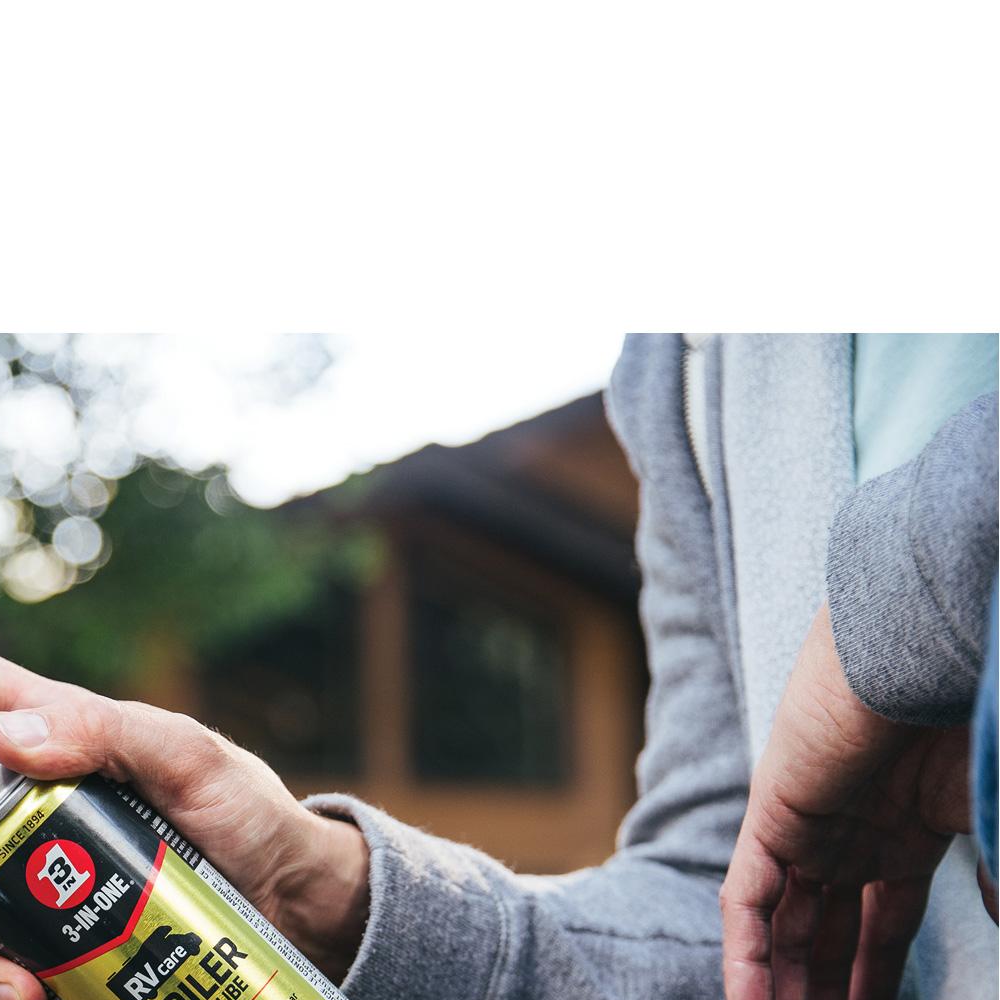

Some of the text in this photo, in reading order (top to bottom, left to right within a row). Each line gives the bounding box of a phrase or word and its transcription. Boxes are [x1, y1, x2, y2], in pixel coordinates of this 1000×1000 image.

[22, 810, 46, 833] 1894
[45, 855, 73, 886] 3
[198, 869, 209, 880] CE
[62, 876, 77, 892] IN
[258, 927, 278, 946] PEUT
[157, 944, 188, 977] care
[276, 945, 309, 977] CONTENU
